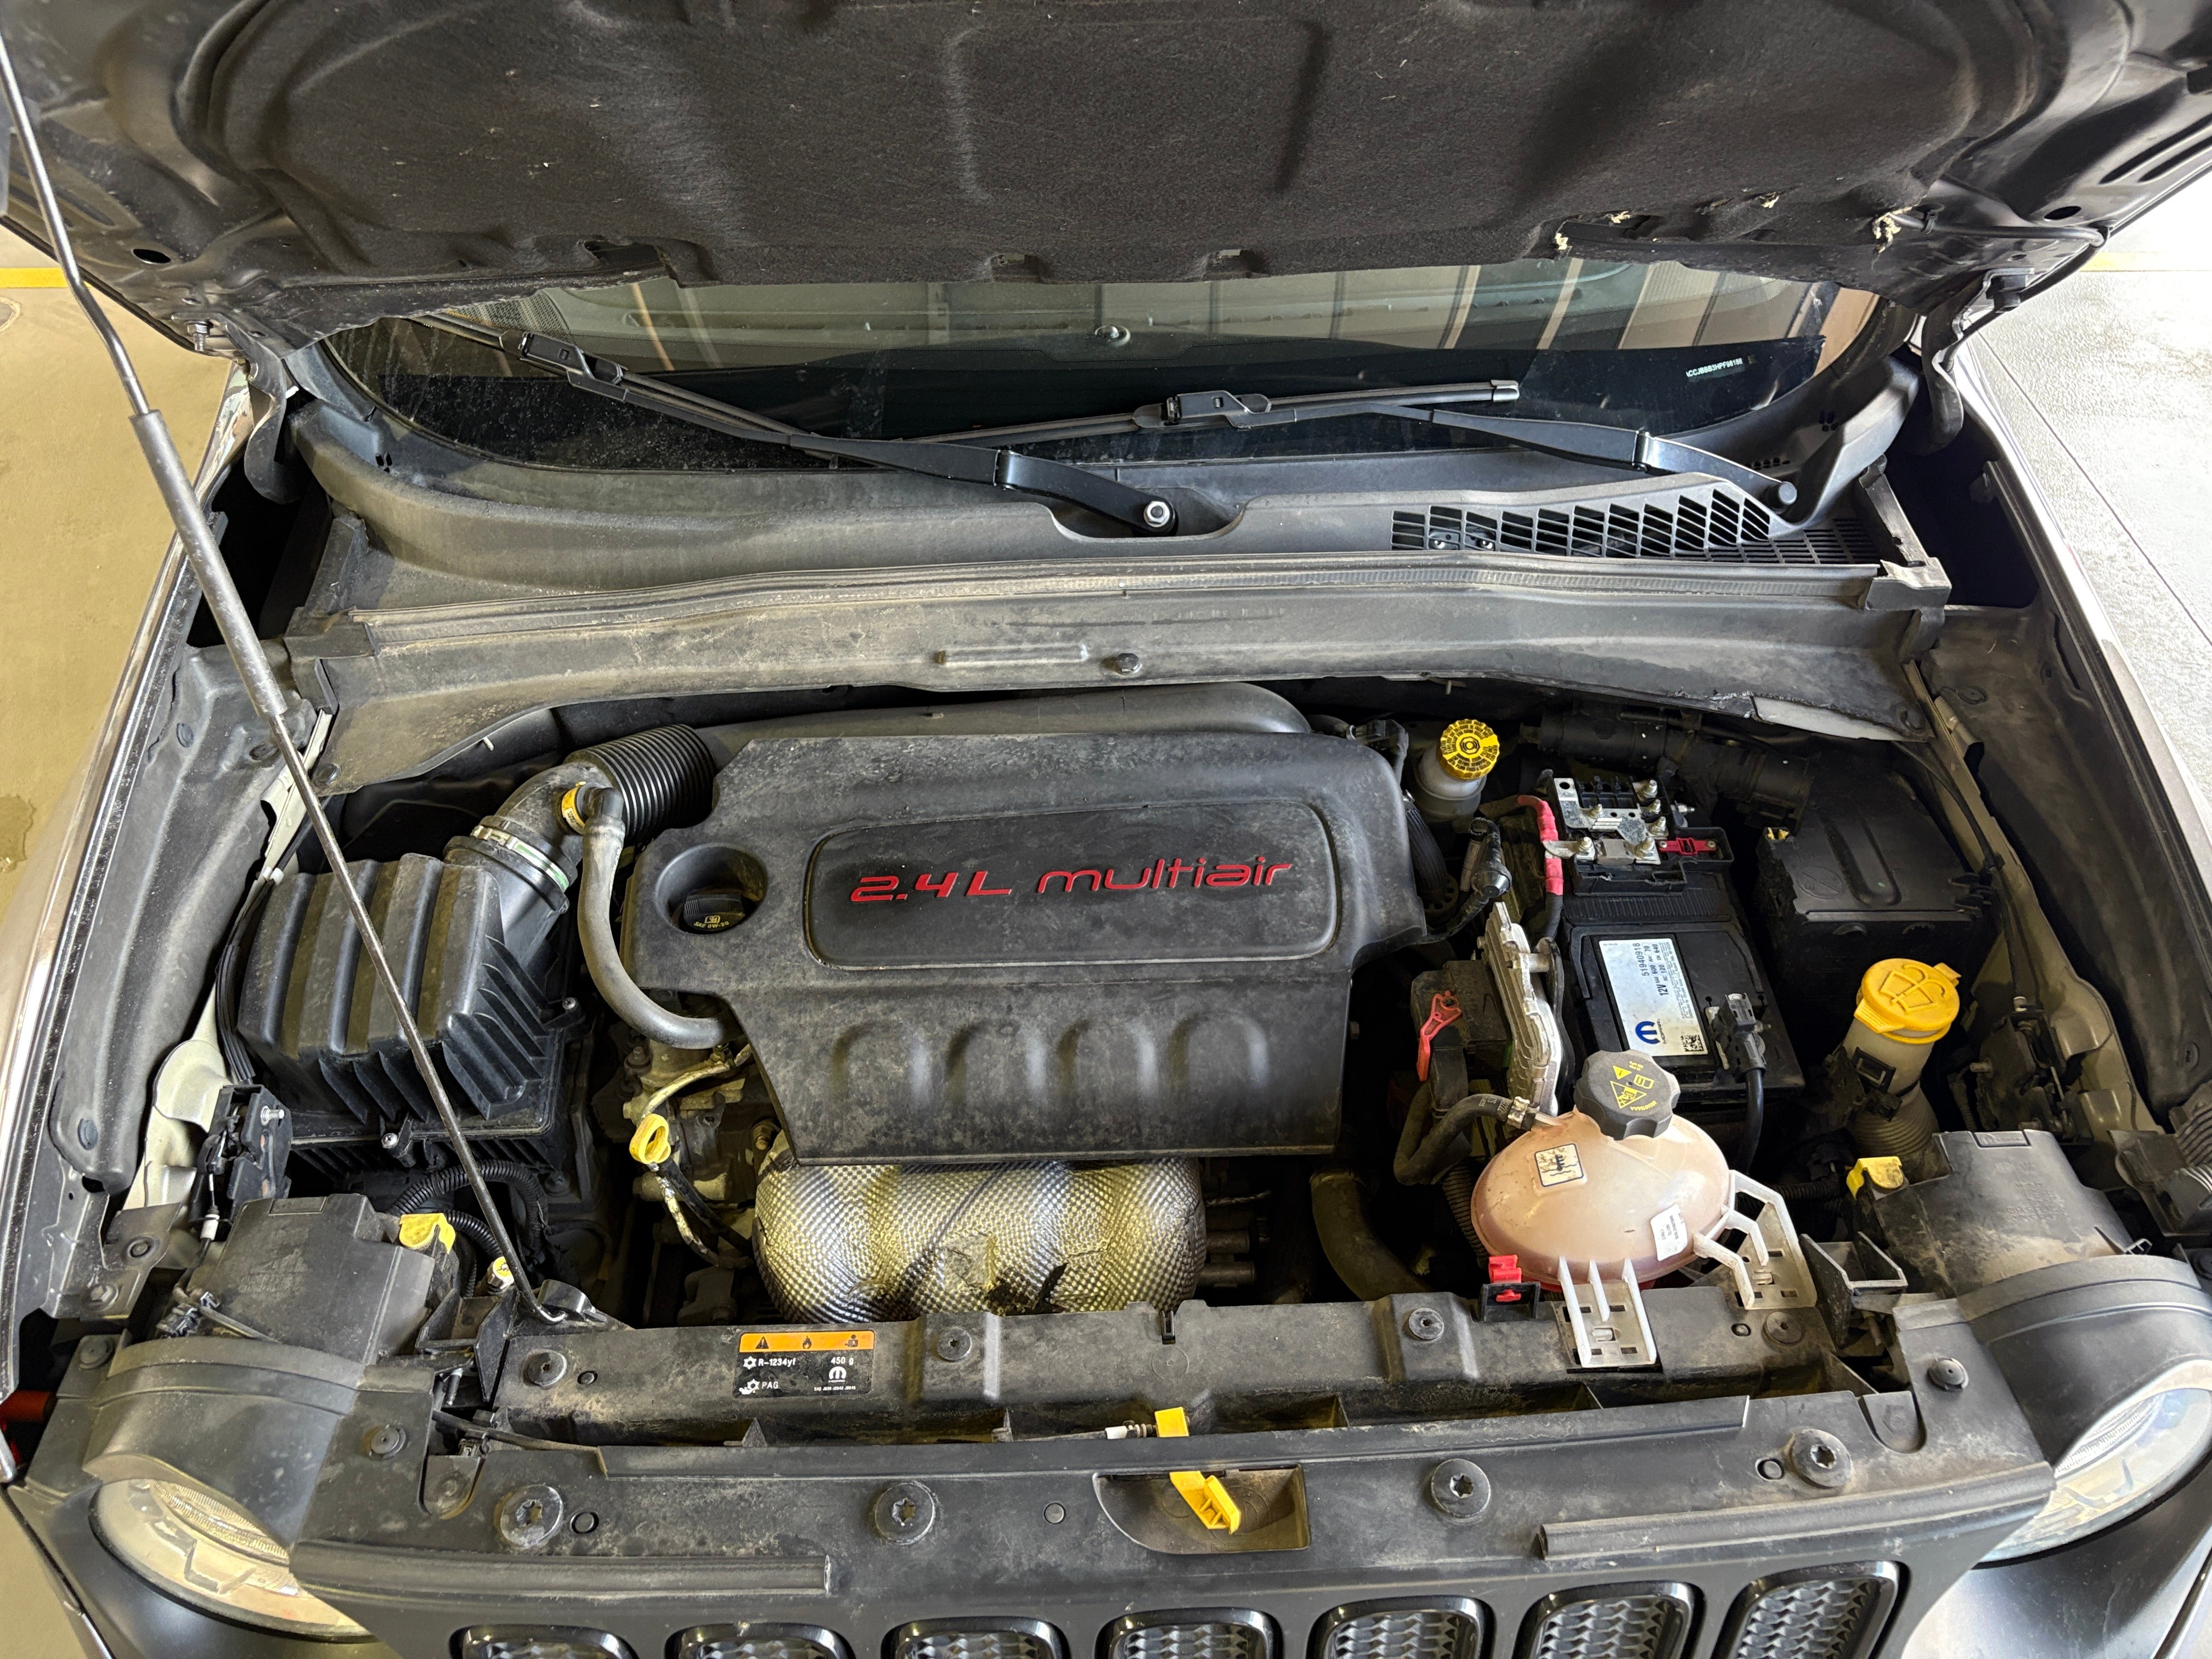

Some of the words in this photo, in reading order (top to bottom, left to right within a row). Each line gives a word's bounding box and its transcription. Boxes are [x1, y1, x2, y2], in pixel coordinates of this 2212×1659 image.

[1038, 856, 1290, 892] multiair
[1633, 943, 1649, 976] 51940918
[1656, 984, 1669, 995] 12V
[758, 1358, 796, 1367] R-1234yf
